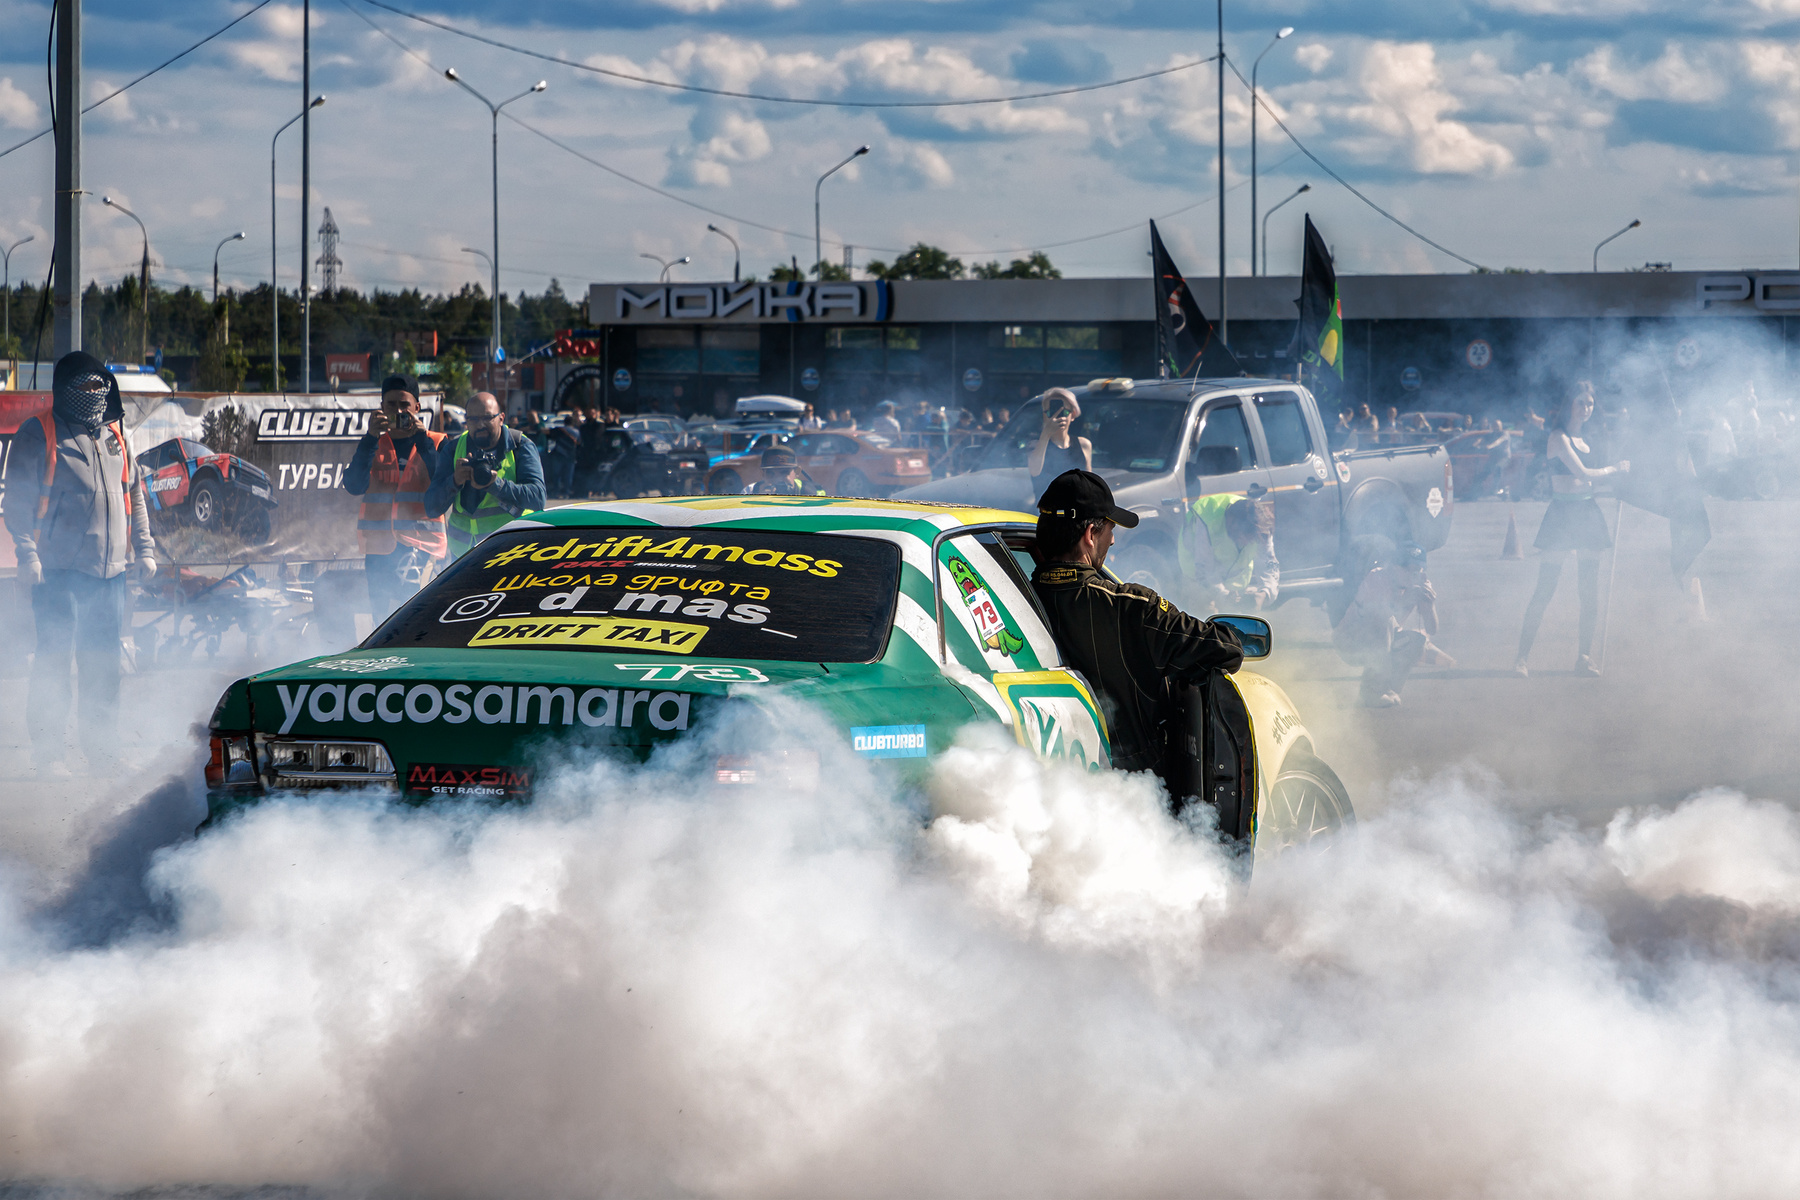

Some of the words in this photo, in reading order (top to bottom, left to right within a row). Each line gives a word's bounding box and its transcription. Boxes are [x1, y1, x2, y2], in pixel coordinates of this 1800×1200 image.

[330, 361, 363, 373] STIHL
[483, 536, 844, 578] #drift4mass
[550, 559, 635, 571] RACE
[491, 573, 619, 593] Школа
[972, 600, 999, 630] 73
[474, 624, 602, 643] DRIFT
[603, 625, 699, 646] TAXI
[614, 663, 770, 684] 73
[276, 683, 691, 735] yaccosamara
[854, 733, 925, 751] CLUBTURBO
[431, 786, 455, 795] GET
[457, 786, 505, 796] RACING
